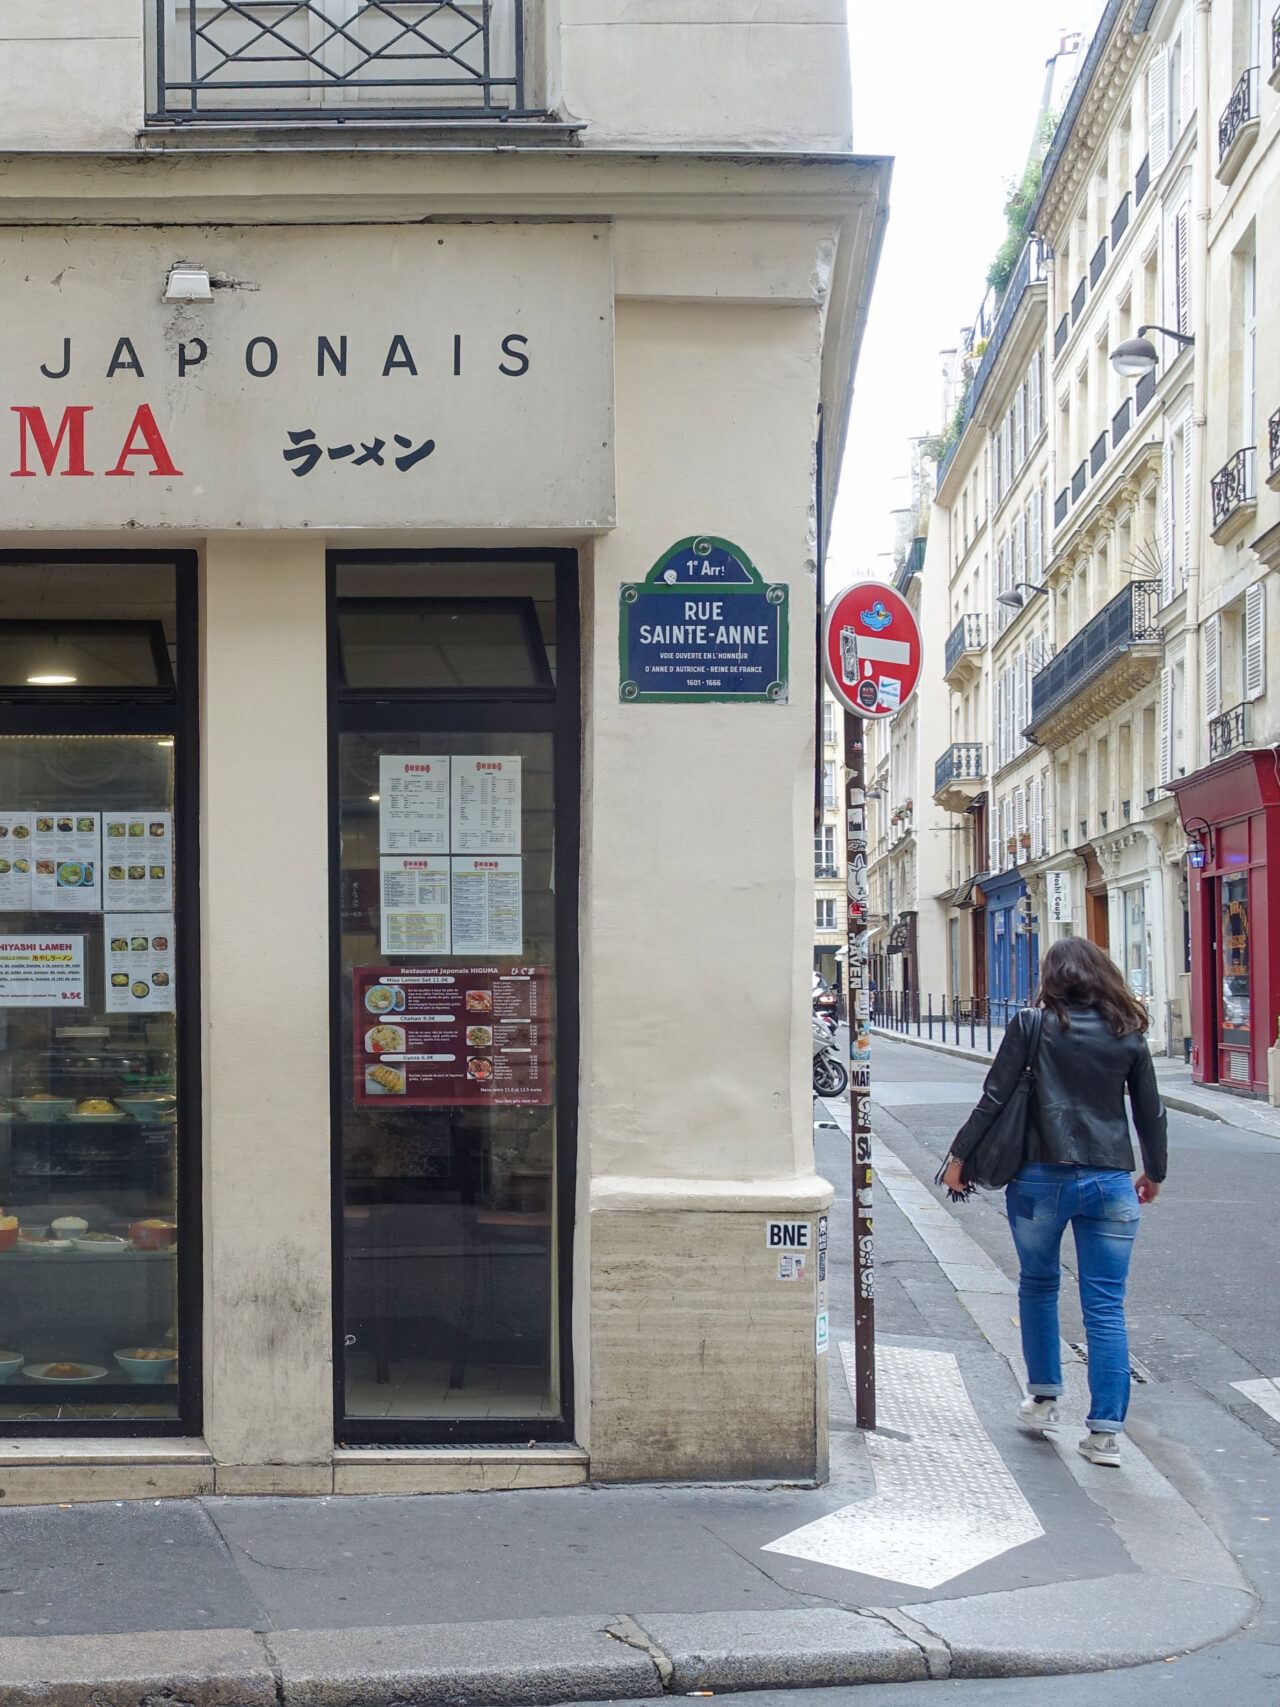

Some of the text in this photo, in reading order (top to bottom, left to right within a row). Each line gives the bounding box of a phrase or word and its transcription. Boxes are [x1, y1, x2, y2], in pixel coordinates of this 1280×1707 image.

[40, 334, 530, 379] JAPONAIS
[283, 428, 436, 477] ラーメン
[684, 601, 724, 621] RUE
[639, 624, 769, 645] SAINTE-ANNE
[660, 652, 674, 660] VOIE
[675, 652, 702, 660] OUVERTE
[703, 652, 712, 660] EN
[710, 665, 729, 673] REINE
[730, 665, 738, 673] DE
[738, 665, 762, 673] FRANCE
[1053, 872, 1062, 921] Hoshi Coupe
[61, 992, 82, 1000] 9.5€
[770, 1224, 808, 1246] BNE
